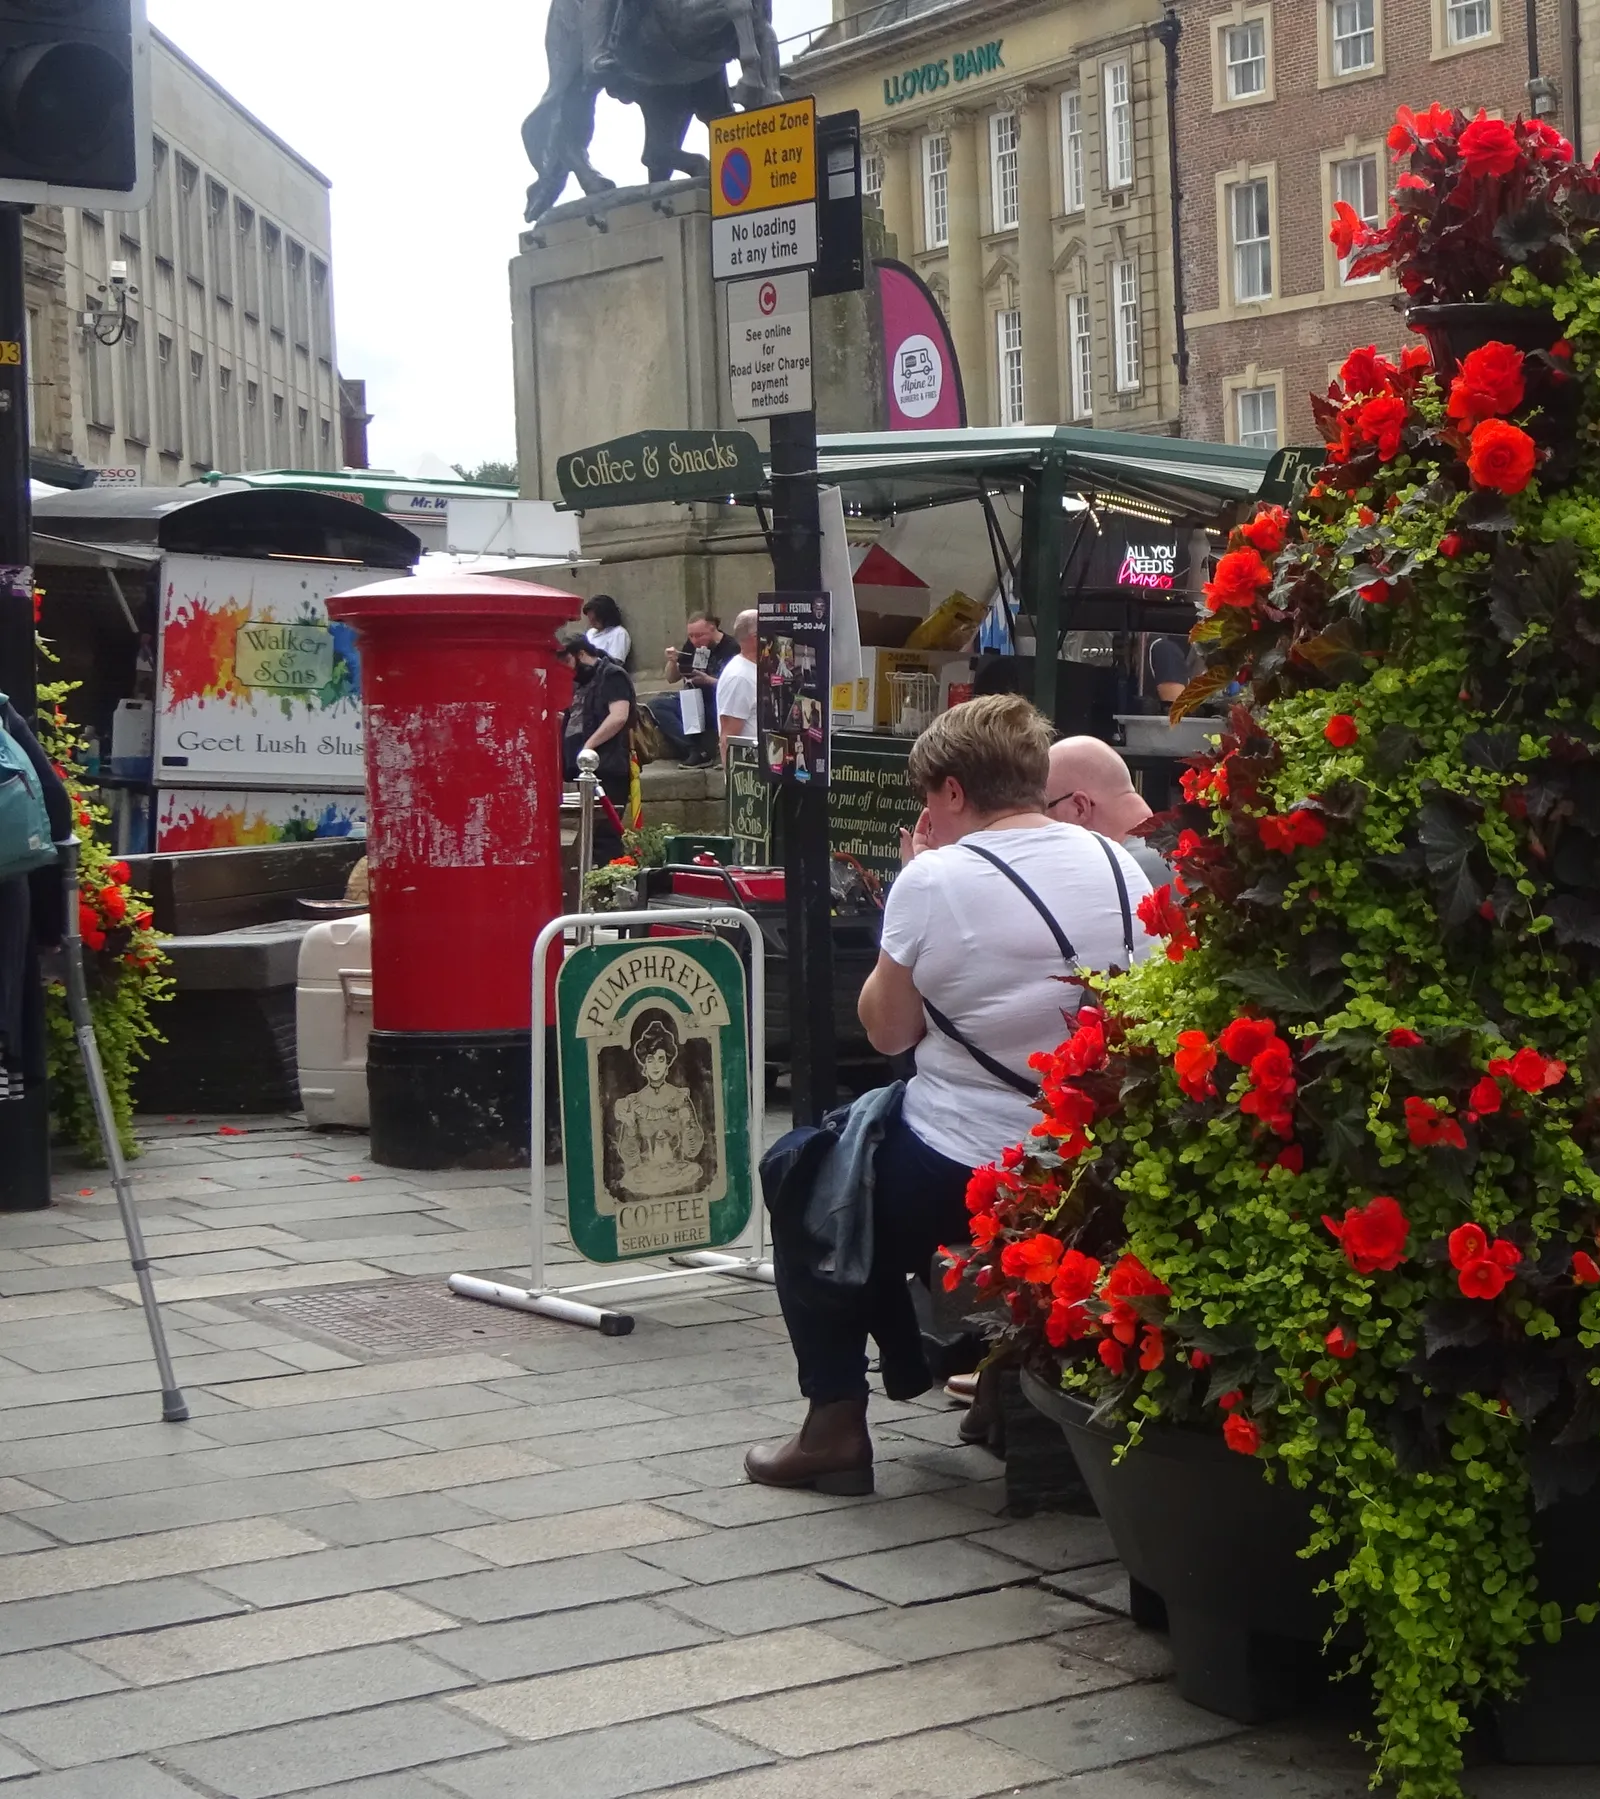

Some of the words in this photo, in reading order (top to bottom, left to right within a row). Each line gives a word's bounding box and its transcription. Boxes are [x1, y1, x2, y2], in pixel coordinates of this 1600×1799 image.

[884, 59, 949, 105] LLOYDS
[953, 39, 1005, 81] BANK
[715, 116, 775, 144] Restricted
[780, 112, 809, 131] Zone
[764, 149, 777, 167] At
[782, 147, 803, 164] any
[770, 171, 797, 188] time
[732, 225, 748, 242] No
[753, 218, 796, 238] loading
[731, 250, 743, 265] at
[747, 247, 767, 264] any
[772, 241, 798, 259] time
[746, 329, 761, 341] See
[765, 324, 791, 339] online
[0, 342, 19, 363] 3
[763, 344, 775, 356] for
[730, 364, 752, 377] Road
[755, 362, 774, 373] User
[778, 357, 810, 370] Charge
[751, 375, 788, 393] payment
[901, 379, 926, 393] Alpine
[928, 375, 935, 387] 21
[752, 392, 789, 407] methods
[570, 450, 636, 488] Coffee
[643, 445, 660, 478] &
[669, 433, 738, 475] Snacks
[411, 496, 432, 508] Mr.
[1126, 546, 1149, 559] ALL
[1151, 545, 1177, 559] YOU
[1130, 560, 1162, 573] NEED
[1164, 560, 1174, 573] IS
[789, 603, 812, 613] FESTIVAL
[813, 622, 826, 632] July
[245, 629, 327, 655] Walker
[279, 652, 297, 668] &
[254, 661, 317, 685] Sons
[177, 731, 245, 752] Geet
[255, 733, 307, 754] Lush
[317, 736, 365, 756] Slus
[734, 770, 766, 800] Walker
[746, 797, 754, 816] &
[828, 792, 837, 803] to
[839, 793, 856, 809] put
[858, 791, 874, 812] off
[876, 793, 893, 812] (an
[737, 807, 762, 835] Sons
[587, 955, 718, 1027] PUMPHREY'S
[619, 1198, 705, 1230] COFFEE
[622, 1233, 669, 1251] SERVED
[674, 1227, 706, 1243] HERE
